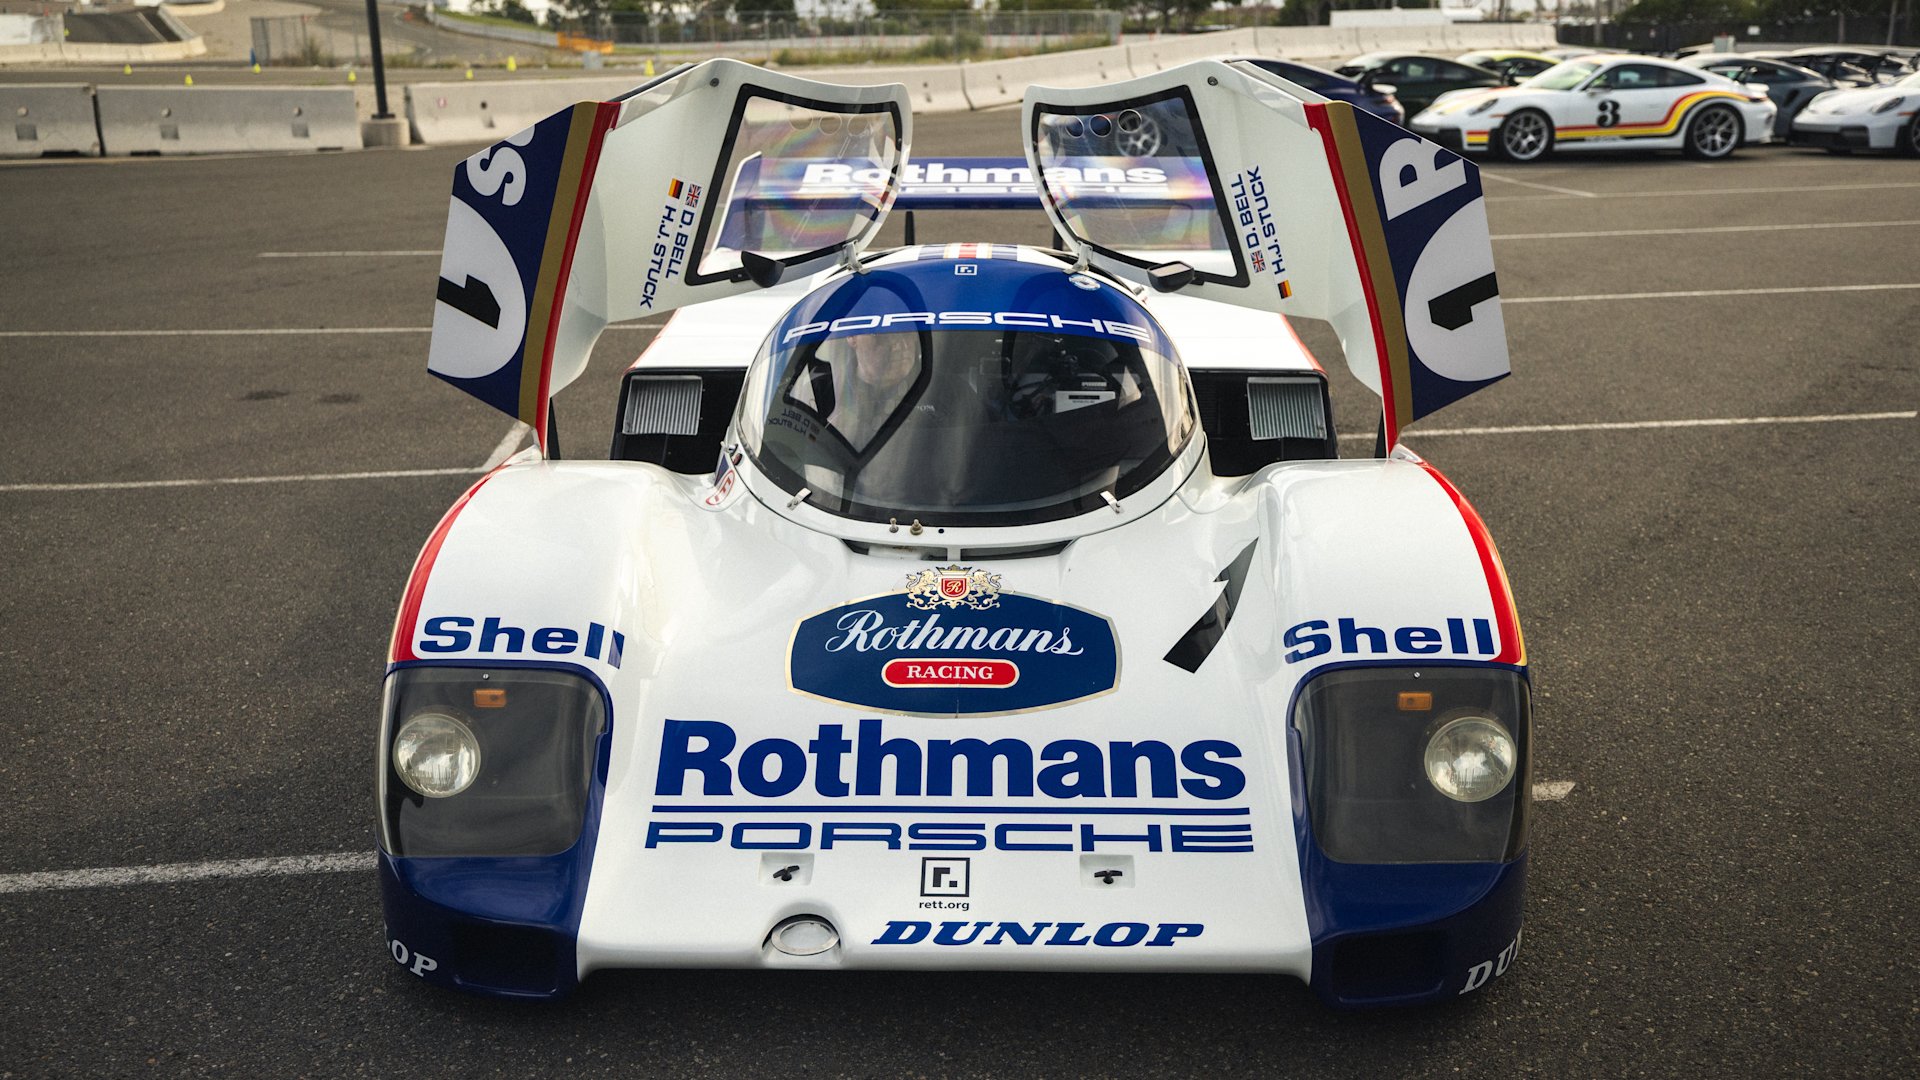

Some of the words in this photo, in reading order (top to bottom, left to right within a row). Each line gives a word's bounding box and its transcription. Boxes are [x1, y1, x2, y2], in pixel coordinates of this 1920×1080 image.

[1596, 99, 1621, 129] 3
[801, 162, 1167, 184] Rothmans
[1231, 173, 1254, 227] BELL
[1247, 165, 1276, 238] STUCK
[657, 205, 677, 239] H.J.
[681, 209, 695, 229] D.
[665, 231, 689, 279] BELL
[1246, 227, 1260, 249] D.
[1268, 238, 1286, 275] H.J.
[640, 242, 666, 309] STUCK
[1428, 271, 1499, 331] 1
[782, 311, 1152, 344] PORSCHE
[419, 616, 625, 669] Shell
[825, 609, 1084, 656] Rothmans
[1283, 617, 1496, 664] Shell
[907, 665, 994, 680] RACING
[655, 719, 1245, 800] Rothmans
[645, 821, 1254, 853] PORSCHE
[919, 900, 970, 912] rett.org
[384, 920, 438, 977] OP
[871, 920, 1204, 947] DUNLOP
